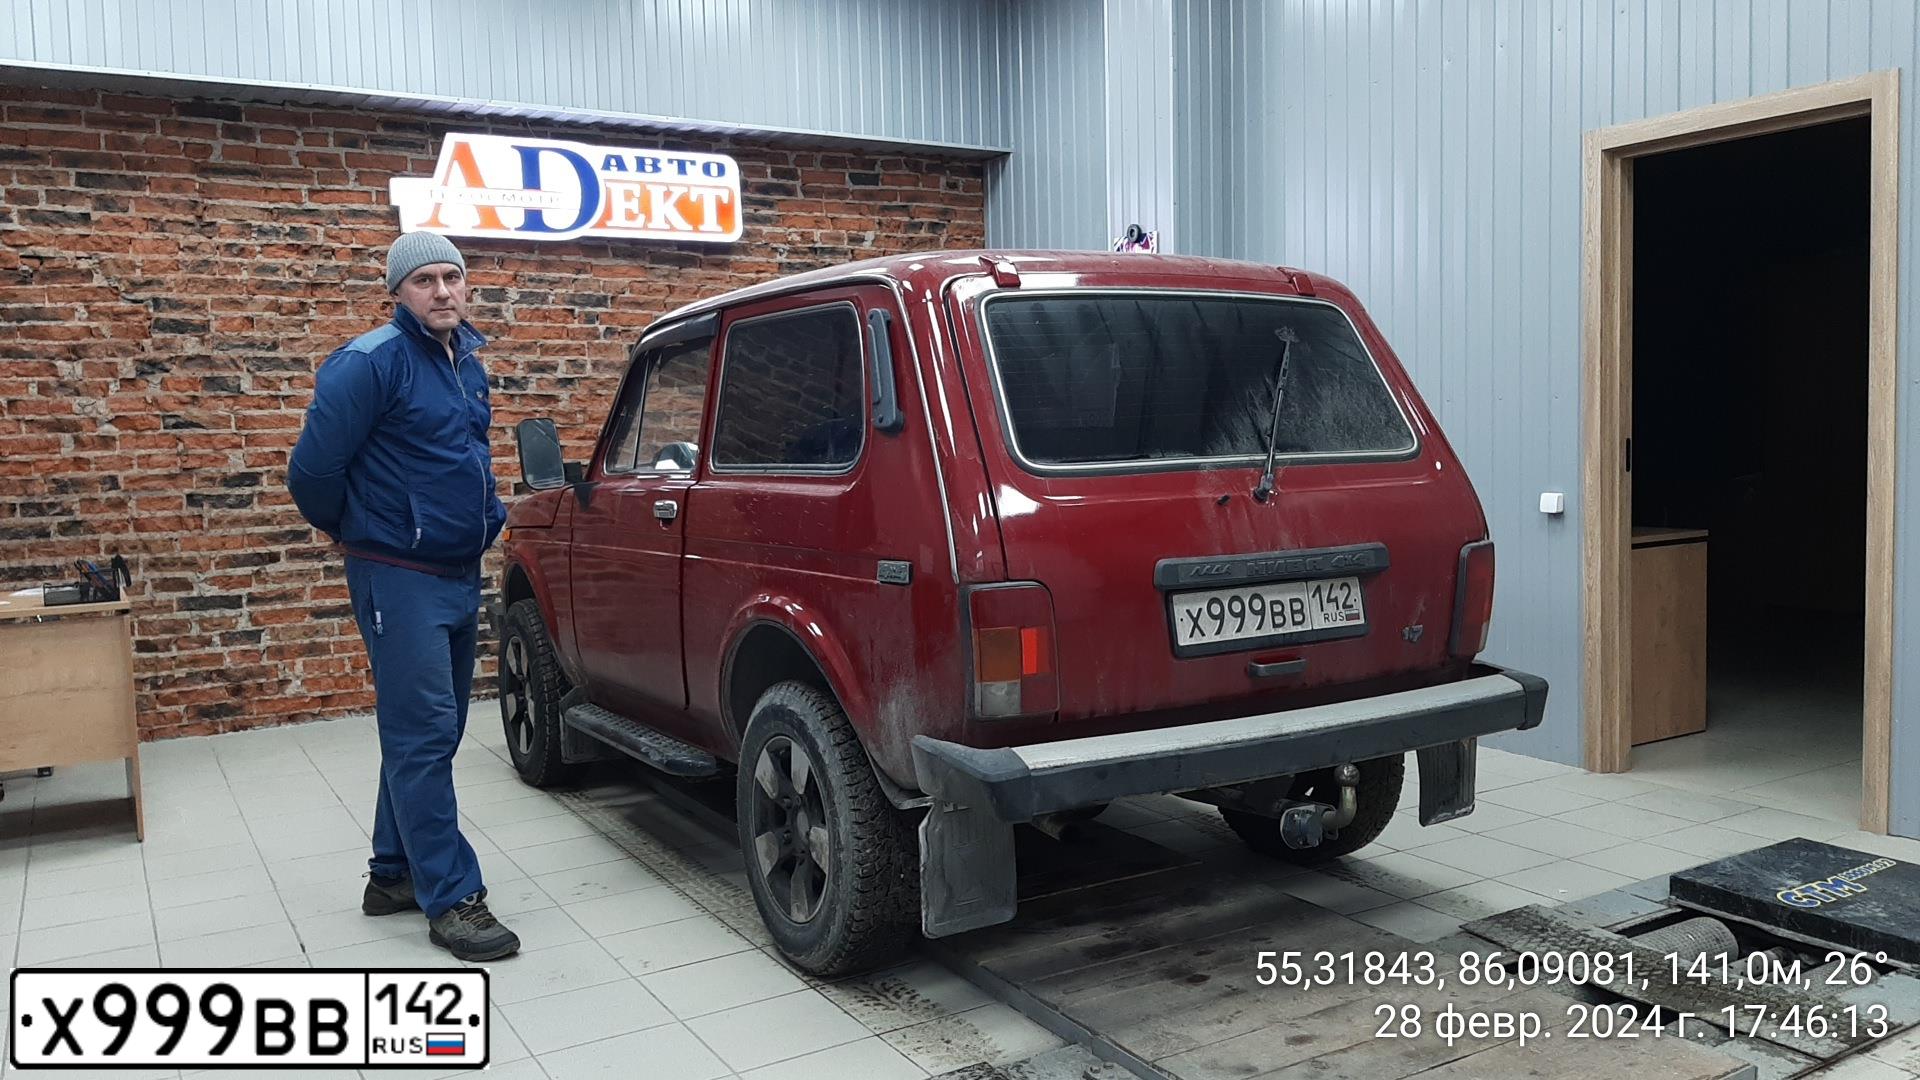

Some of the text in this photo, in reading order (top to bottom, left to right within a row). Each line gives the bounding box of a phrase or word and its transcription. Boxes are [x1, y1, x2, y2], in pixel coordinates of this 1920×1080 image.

[600, 153, 727, 178] АВТО
[1185, 582, 1354, 639] Х999ВВ 142
[1323, 611, 1345, 623] RUS
